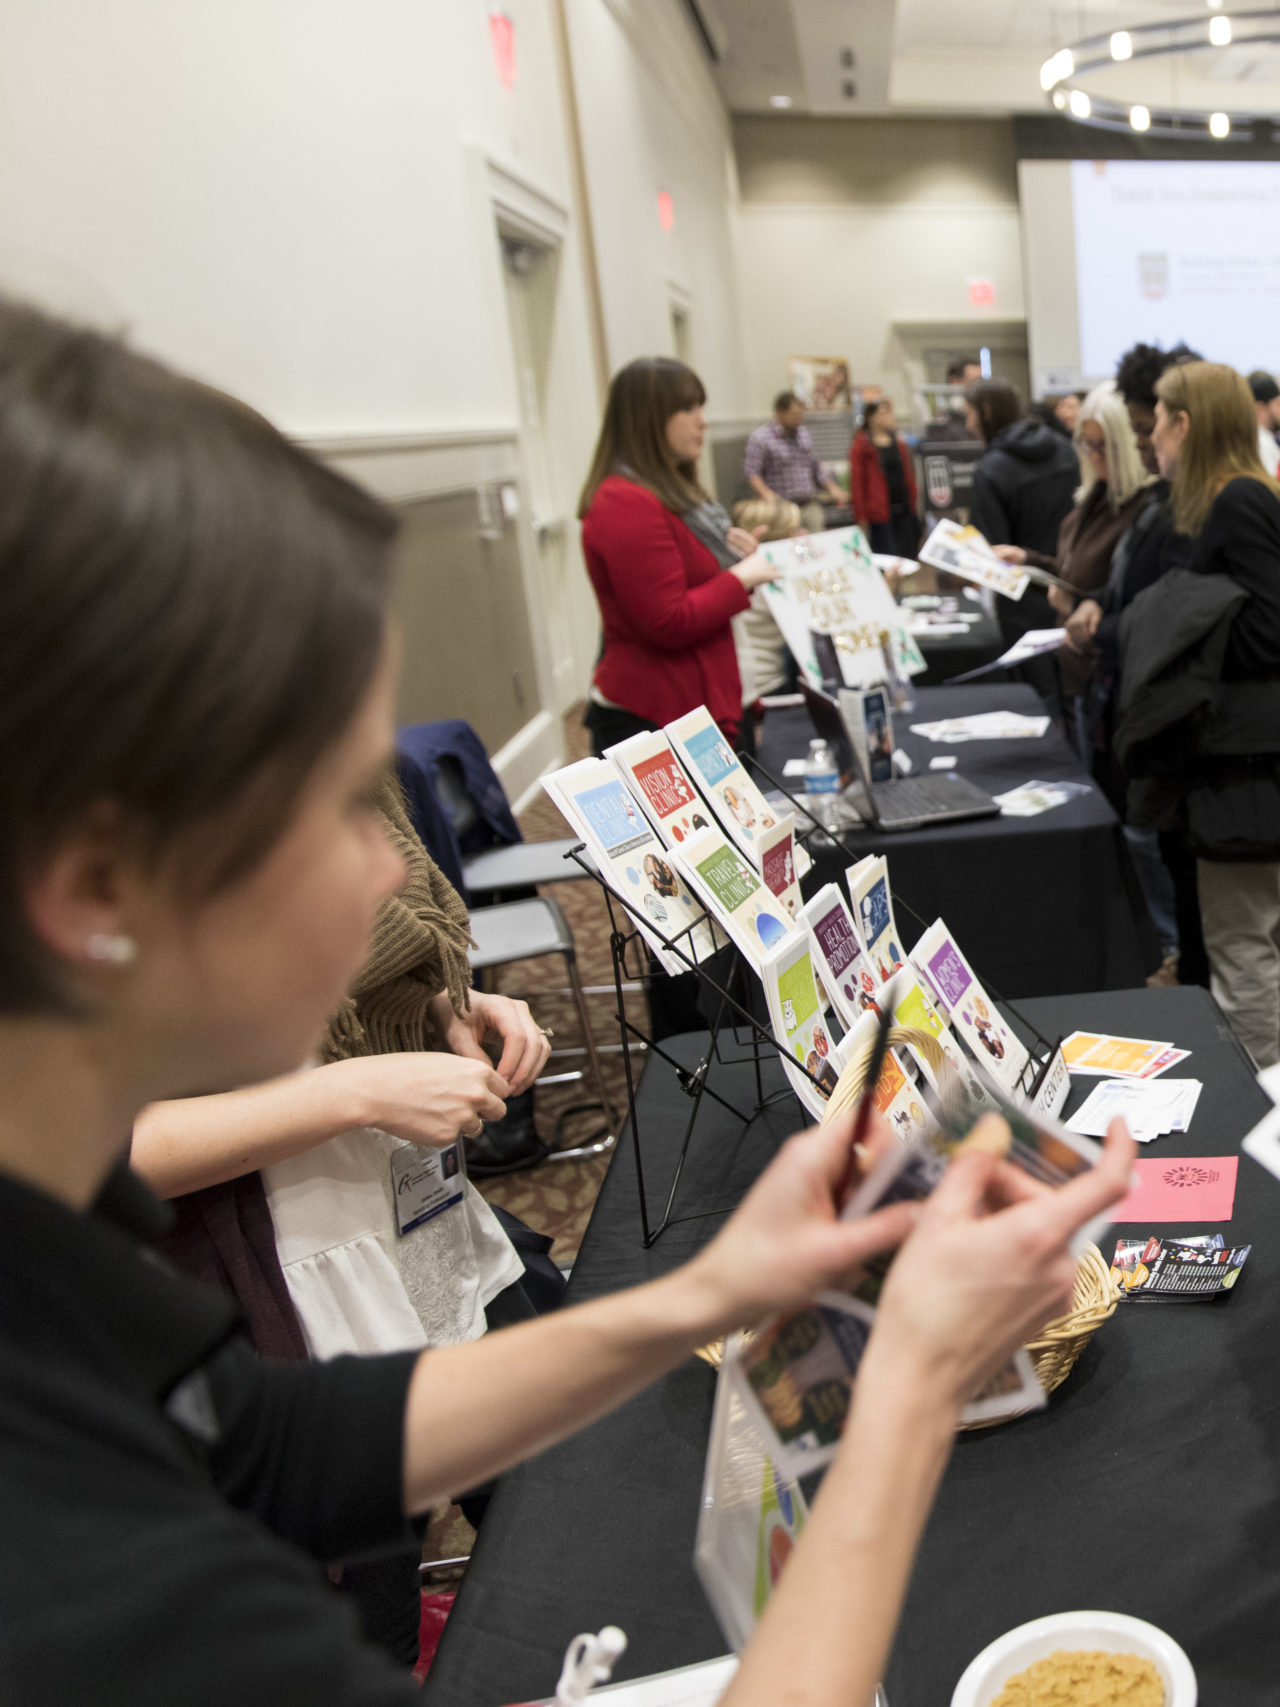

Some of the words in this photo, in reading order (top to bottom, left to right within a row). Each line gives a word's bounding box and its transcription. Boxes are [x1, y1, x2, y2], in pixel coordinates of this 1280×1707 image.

[640, 766, 672, 796] VISION
[650, 786, 683, 815] CLINIC
[706, 858, 738, 888] TRAVEL
[720, 877, 751, 909] CLINIC
[824, 914, 853, 952] HEALTH
[826, 933, 860, 973] PROMOTION
[1044, 1059, 1064, 1108] CENTER
